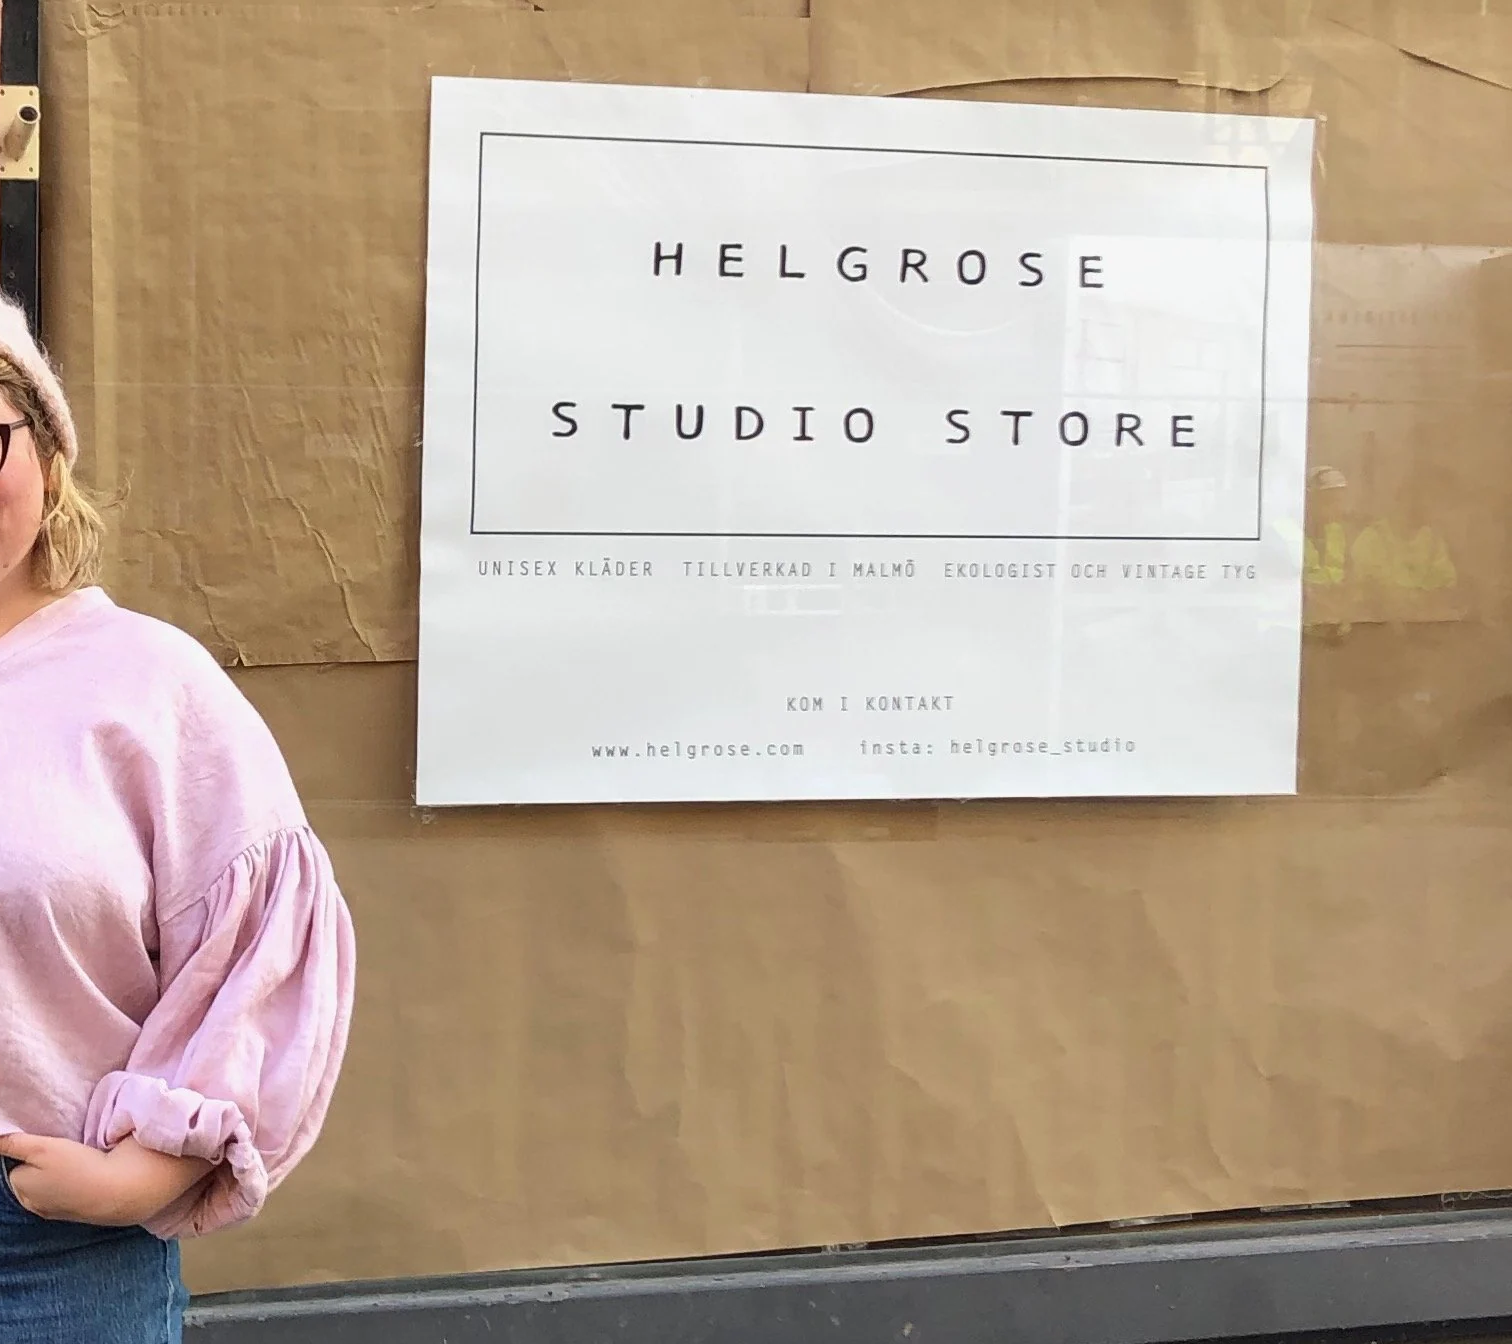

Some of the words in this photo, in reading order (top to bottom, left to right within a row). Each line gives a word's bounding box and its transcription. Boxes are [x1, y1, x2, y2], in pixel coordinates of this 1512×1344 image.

[652, 241, 1106, 289] HELGROSE
[551, 401, 876, 444] STUDIO
[945, 408, 1197, 448] STORE
[478, 560, 558, 577] UNISEX
[575, 557, 654, 577] KLÄDER
[683, 560, 814, 577] TILLVERKAD
[828, 561, 838, 578] I
[852, 558, 917, 578] MALMÖ
[944, 562, 1060, 579] EKOLOGIST
[1070, 562, 1109, 579] OCH
[1121, 563, 1209, 580] VINTAGE
[1221, 564, 1258, 580] TYG
[787, 696, 826, 712] KOM
[840, 696, 850, 712] I
[865, 695, 956, 712] KONTAKT
[591, 740, 806, 760] www.helgrose.com
[950, 737, 1137, 758] helgrose_studio
